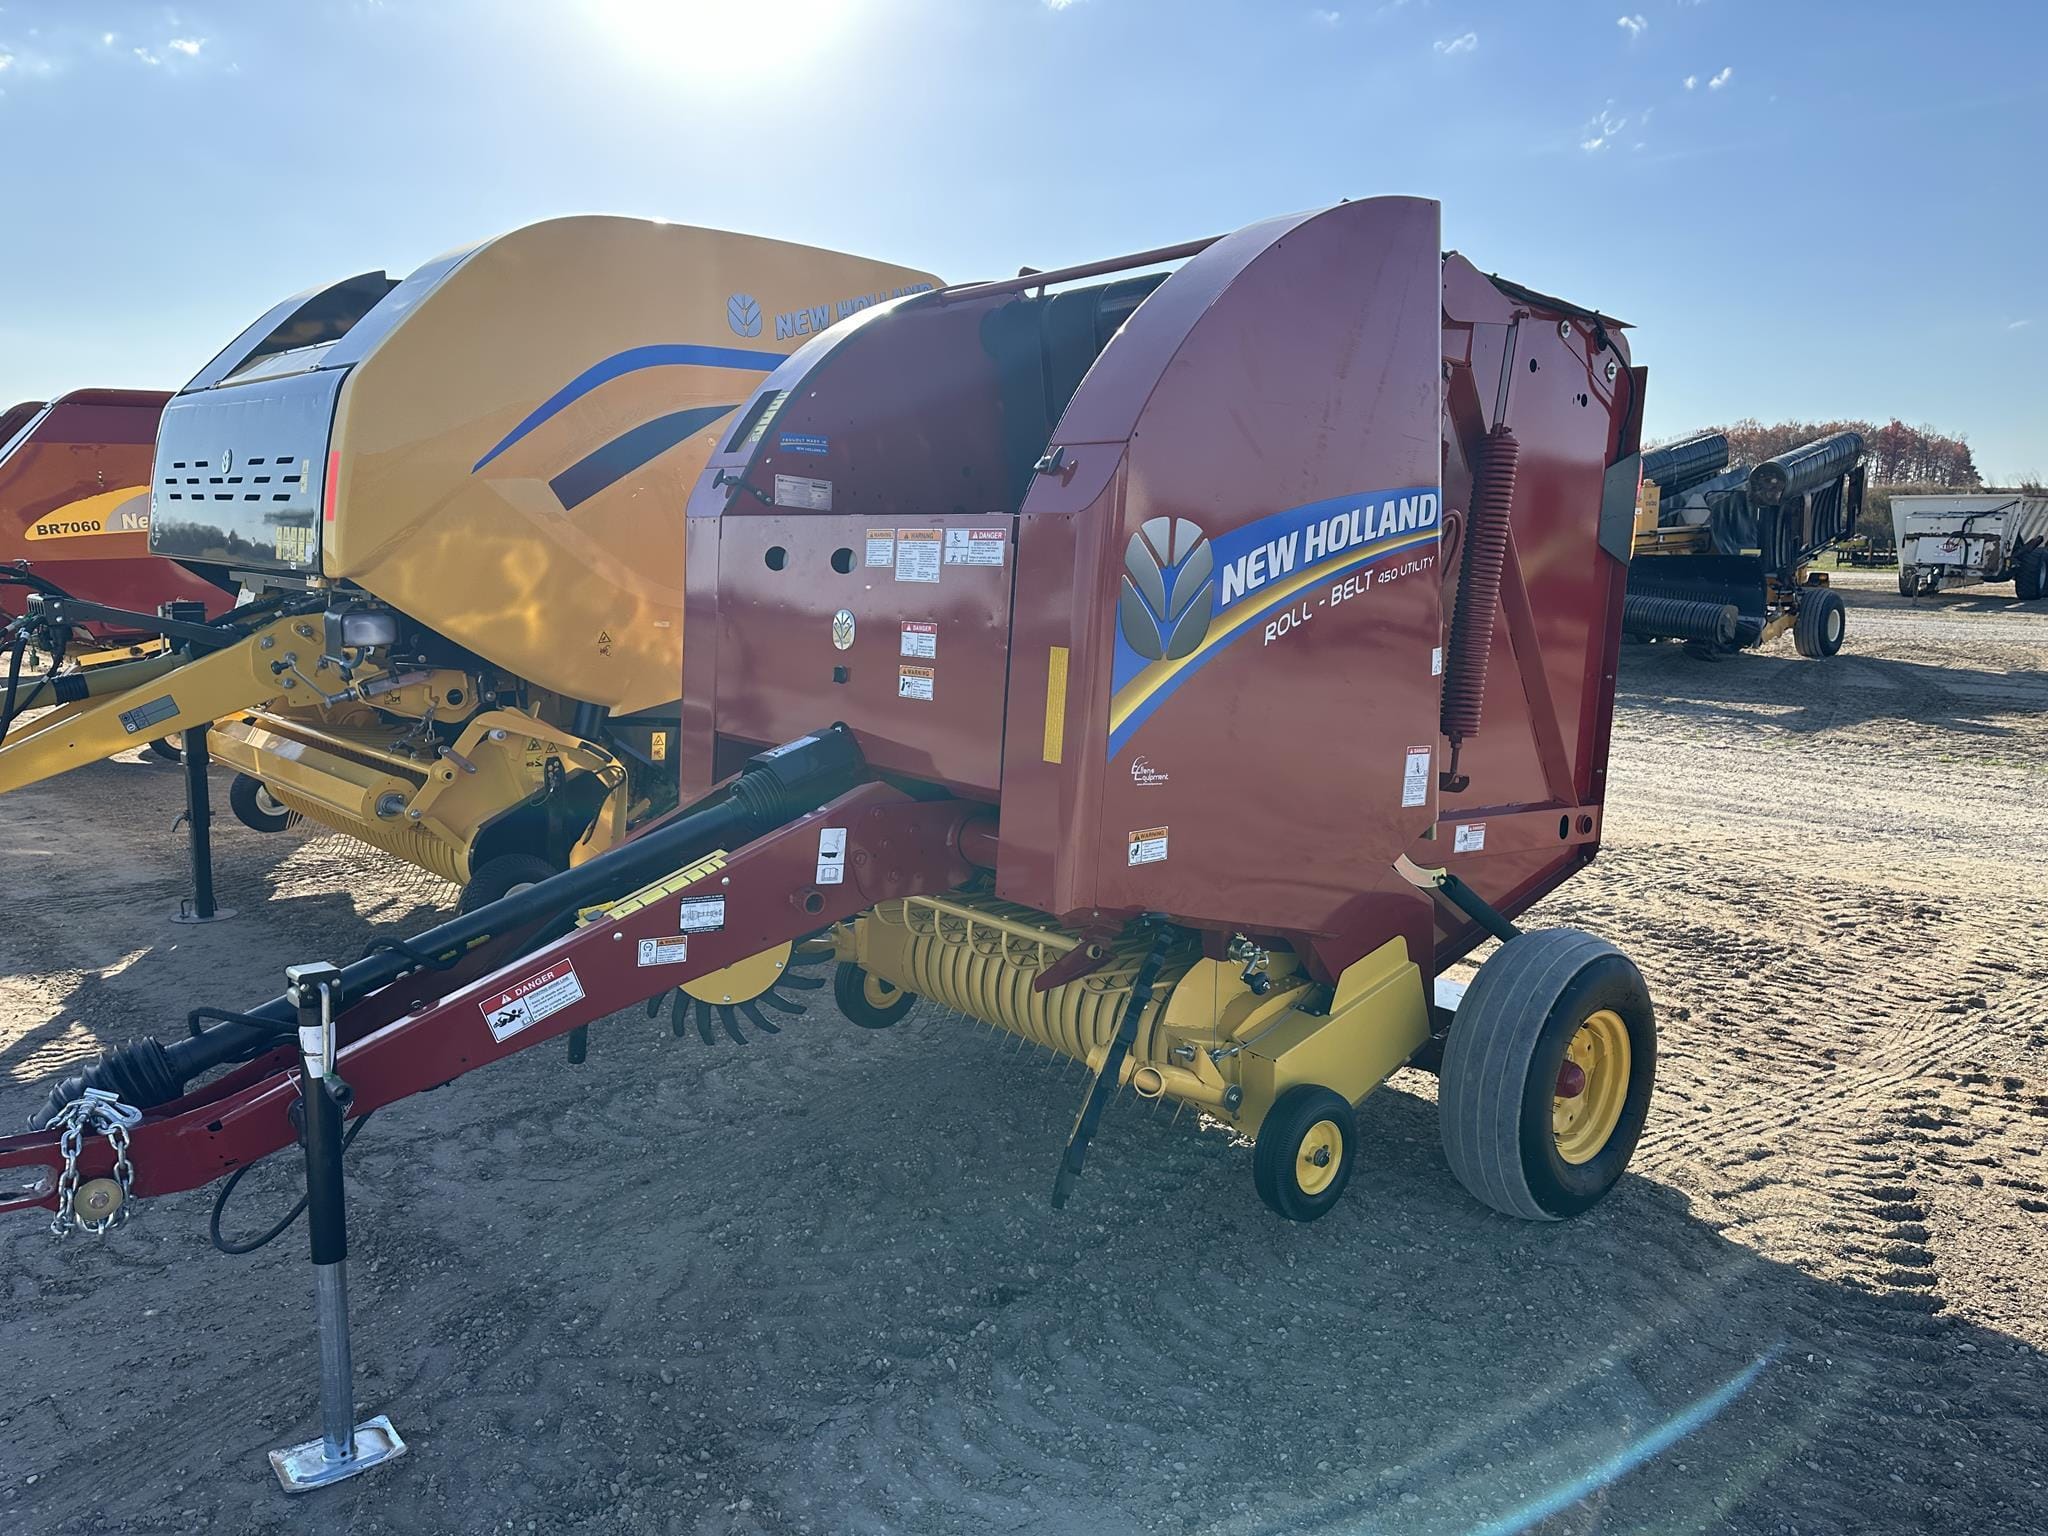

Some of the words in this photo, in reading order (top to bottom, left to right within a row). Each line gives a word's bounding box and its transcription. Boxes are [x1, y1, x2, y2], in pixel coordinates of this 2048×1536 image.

[775, 303, 830, 340] NEW
[36, 520, 101, 536] BR7060
[121, 513, 149, 529] Ne
[979, 531, 1003, 539] DANGER
[1222, 531, 1298, 606] NEW
[1304, 493, 1437, 563] HOLLAND
[1264, 602, 1312, 646] ROLL
[1330, 569, 1373, 607] BELT
[1377, 567, 1398, 584] 450
[1400, 555, 1435, 576] UTILITY
[514, 972, 555, 996] DANGER
